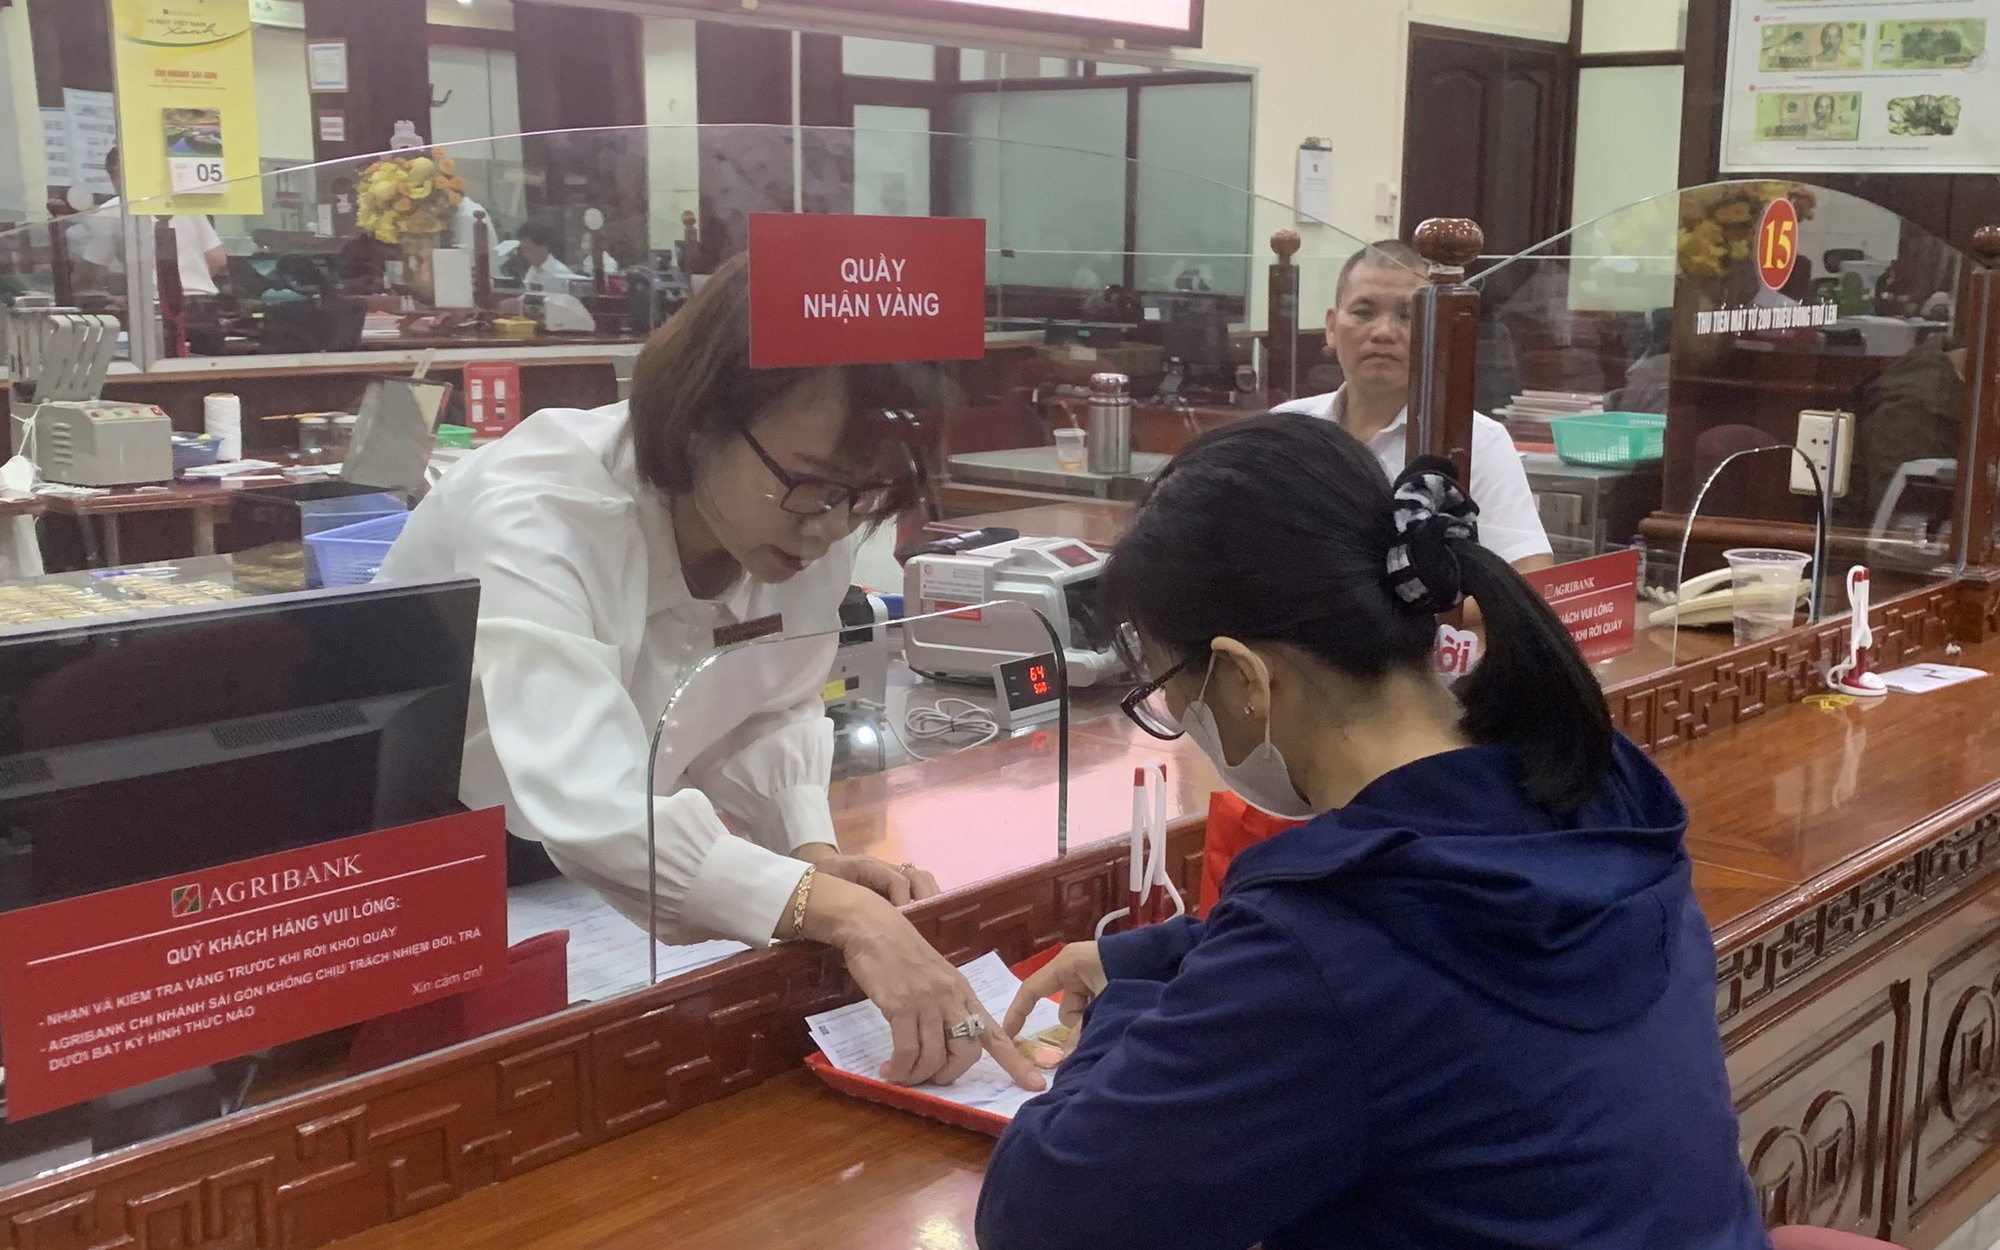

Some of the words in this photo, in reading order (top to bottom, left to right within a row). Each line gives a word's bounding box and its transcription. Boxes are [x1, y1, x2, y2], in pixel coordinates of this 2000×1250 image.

[196, 163, 222, 182] 05
[1762, 219, 1793, 269] 15
[840, 253, 906, 284] QUẦY
[803, 289, 869, 323] NHẬN
[876, 286, 939, 317] VÀNG
[1553, 577, 1595, 597] AGRIBANK
[1559, 610, 1579, 624] HÁCH
[1580, 606, 1593, 620] VUI
[1575, 628, 1588, 642] KHI
[1436, 635, 1470, 673] ời
[1029, 665, 1045, 681] 64
[207, 853, 363, 909] AGRIBANK
[208, 926, 267, 955] KHÁCH
[272, 915, 318, 939] HÀNG
[322, 907, 348, 927] VUI
[155, 982, 183, 998] TRA
[186, 971, 224, 989] VÀNG
[279, 951, 301, 967] KHI
[48, 1022, 125, 1052] AGRIBANK
[129, 1015, 153, 1031] CHI
[156, 999, 205, 1023] NHÁNH
